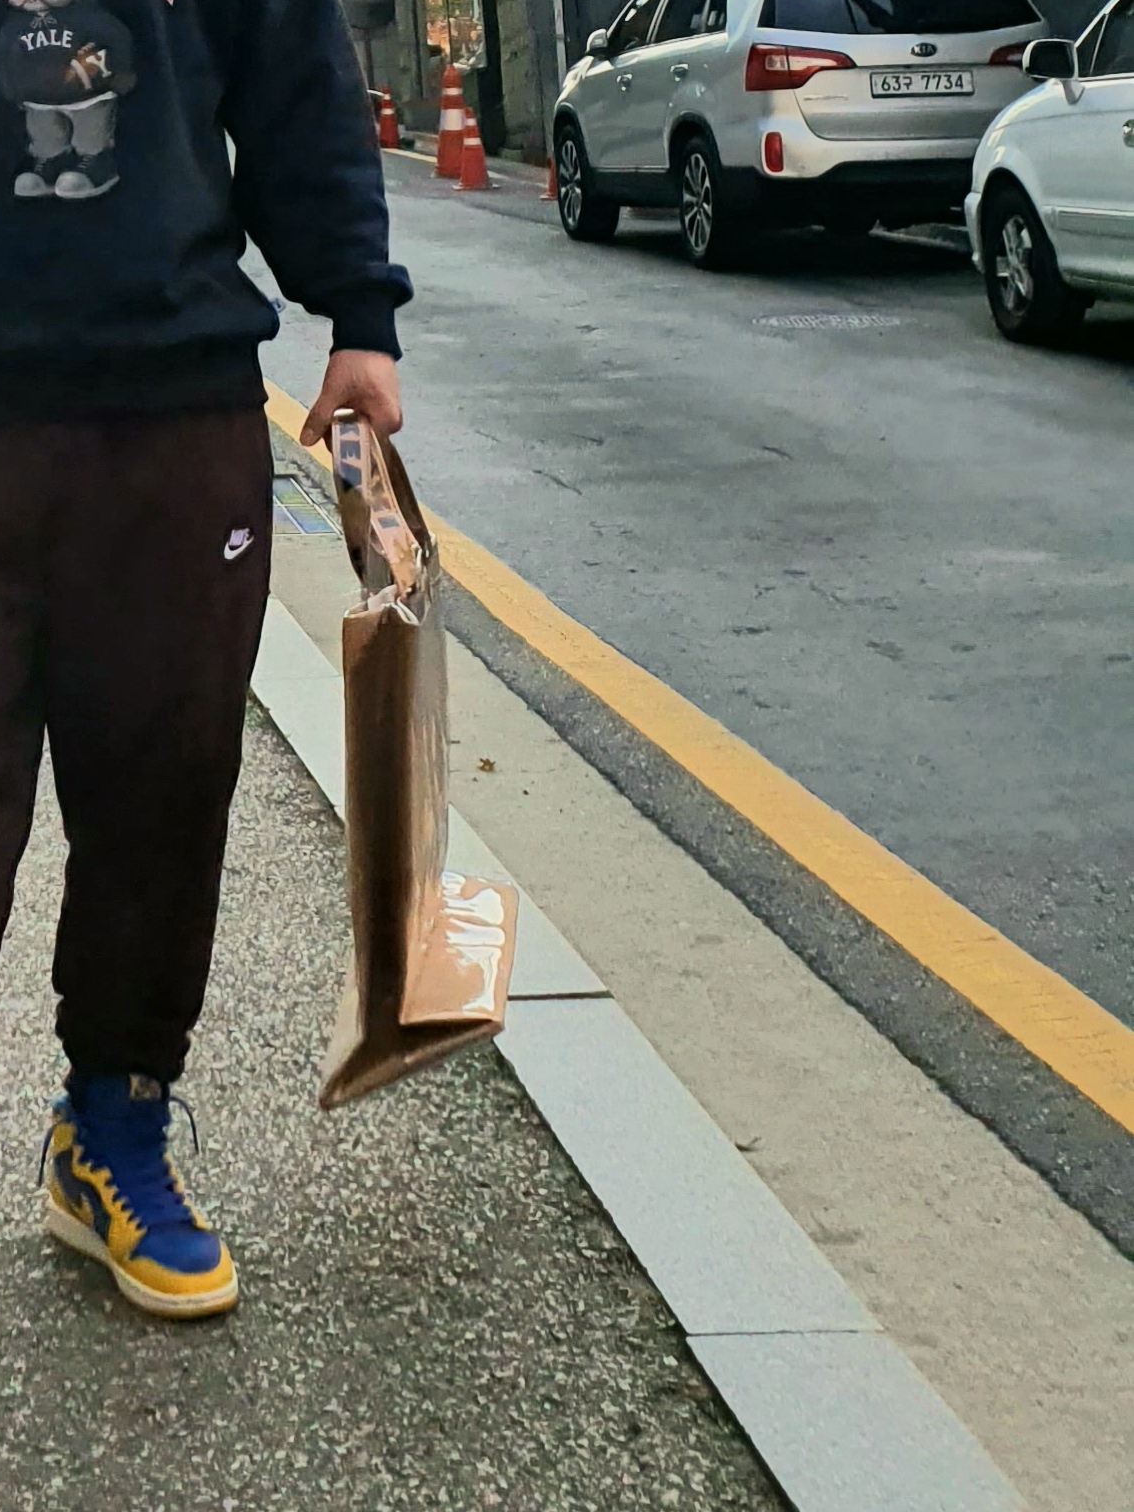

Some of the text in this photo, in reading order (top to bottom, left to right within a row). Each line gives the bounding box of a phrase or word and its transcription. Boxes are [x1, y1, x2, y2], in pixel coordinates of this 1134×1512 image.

[20, 29, 74, 51] YALE
[913, 44, 935, 54] KIA
[921, 73, 964, 90] 7734
